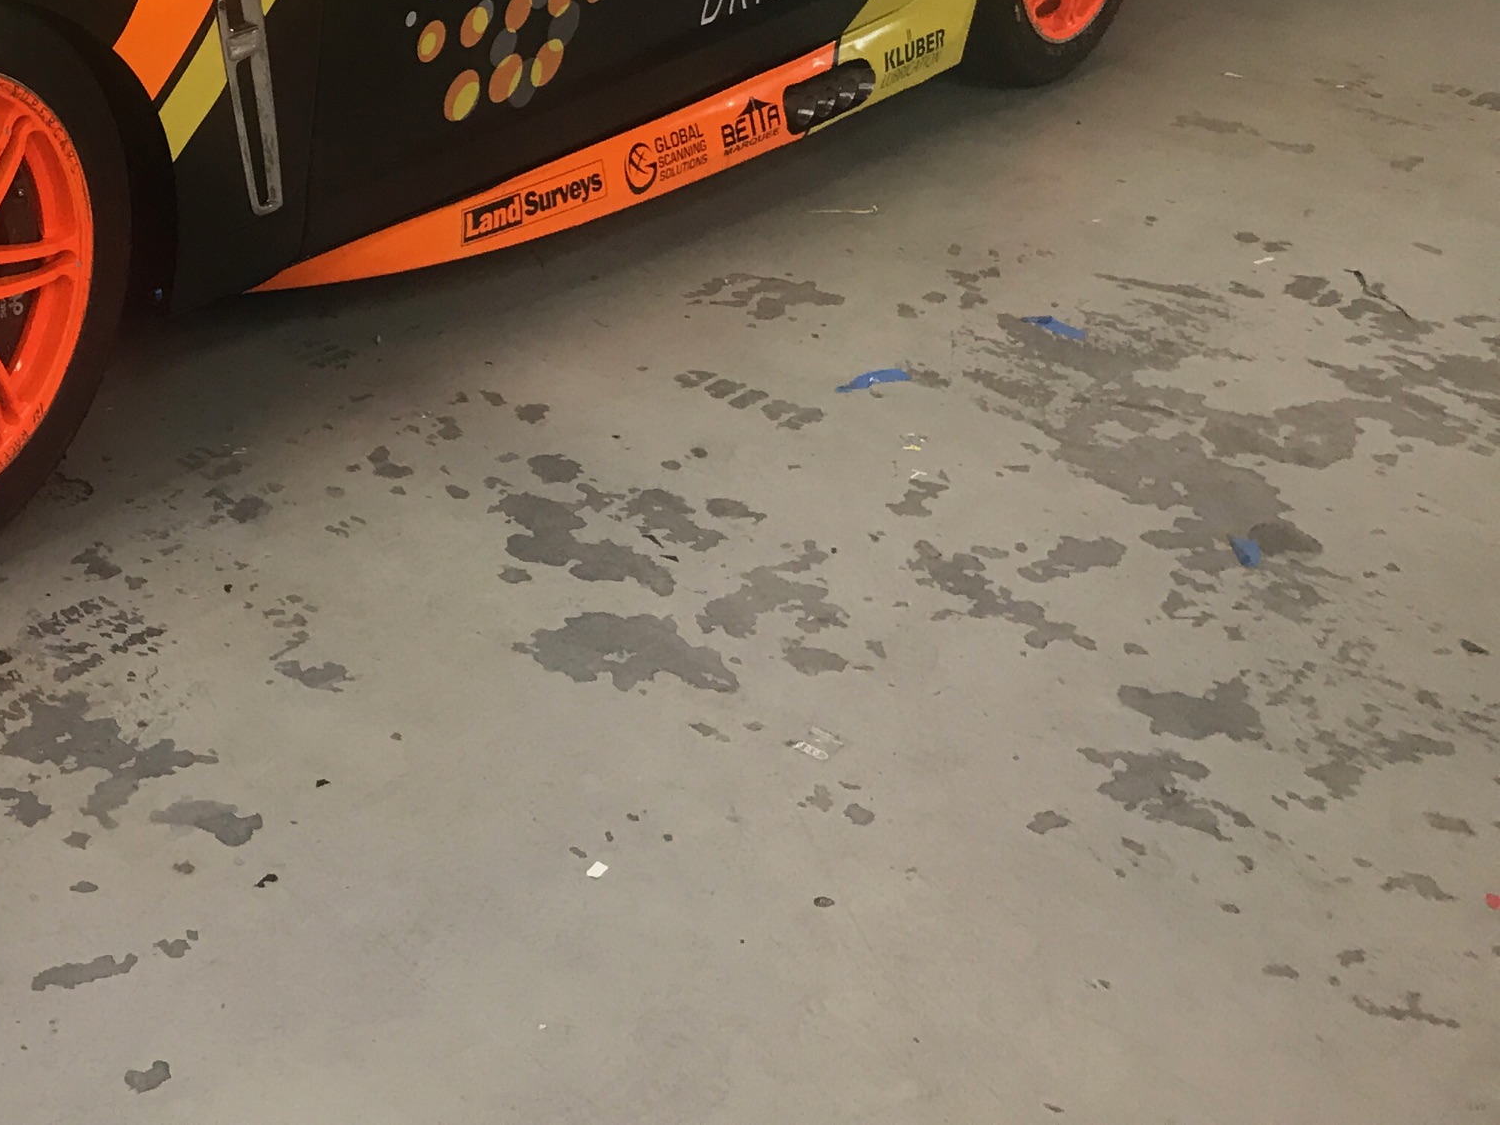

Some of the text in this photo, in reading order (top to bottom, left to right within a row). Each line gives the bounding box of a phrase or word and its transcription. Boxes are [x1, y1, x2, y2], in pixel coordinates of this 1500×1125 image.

[654, 122, 705, 154] GLOBAL
[657, 139, 708, 169] SCANNING
[659, 155, 709, 183] SOLUTIONS
[465, 171, 604, 241] Land Surveys
